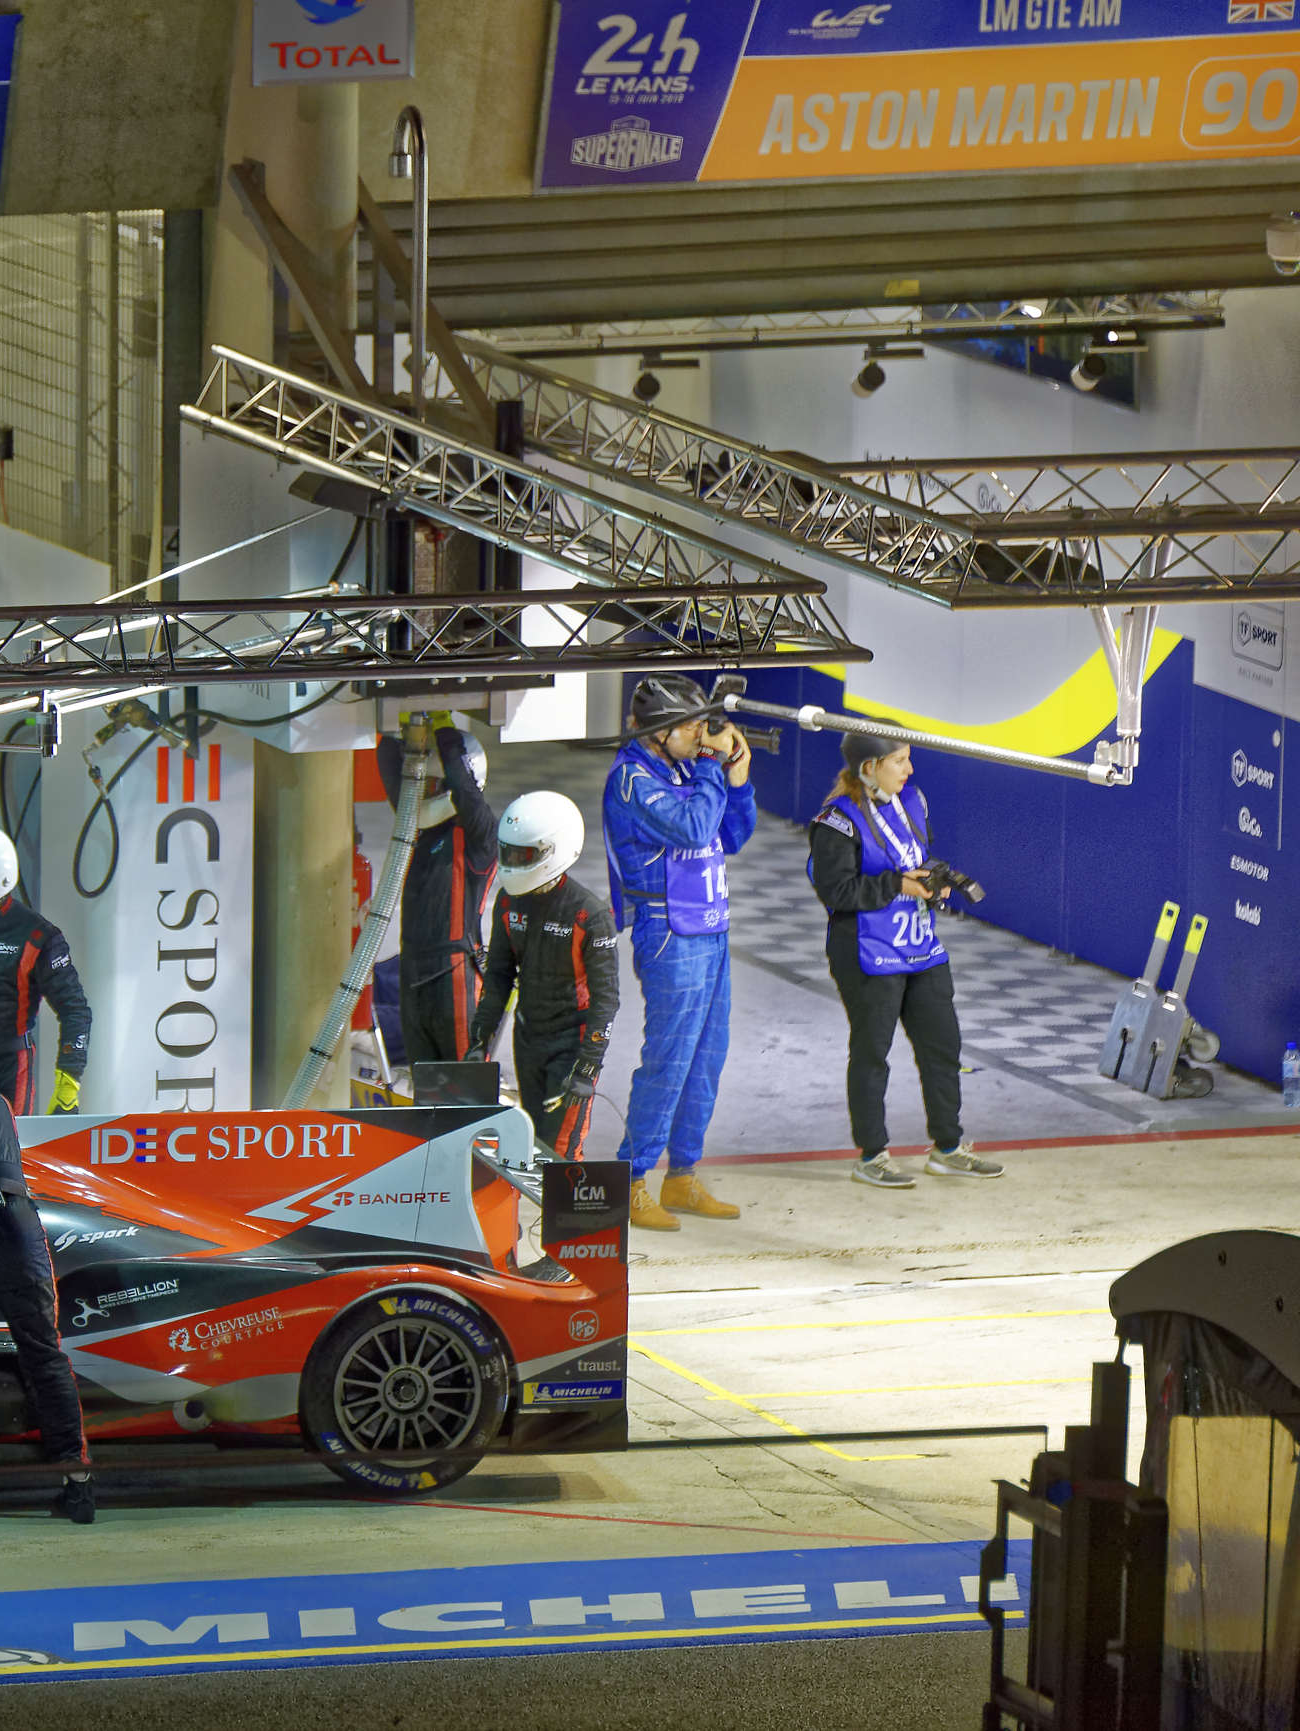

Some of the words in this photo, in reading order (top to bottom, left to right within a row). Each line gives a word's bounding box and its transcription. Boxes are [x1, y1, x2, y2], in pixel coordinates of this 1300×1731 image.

[979, 0, 1019, 33] LM
[269, 42, 400, 70] TOTAL
[581, 12, 700, 75] 24h
[575, 77, 610, 95] LE
[612, 75, 690, 94] MANS
[757, 88, 940, 155] ASTON
[948, 76, 1160, 148] MARTIN
[1199, 68, 1298, 136] 90
[573, 130, 680, 170] SUPERFINALE
[1252, 625, 1278, 648] SPORT
[1247, 764, 1275, 790] SPORT
[155, 888, 220, 1112] SPOR
[90, 1126, 198, 1165] IDEC
[207, 1123, 363, 1161] SPORT
[359, 1190, 451, 1206] BANORTE
[573, 1185, 605, 1201] ICM
[79, 1226, 140, 1244] spark
[558, 1243, 619, 1260] MOTUL
[97, 1279, 178, 1305] REBELLION
[194, 1306, 280, 1339] CHEVREUSE
[200, 1320, 284, 1351] COURTAGE
[414, 1298, 488, 1348] MICHELIN
[577, 1358, 621, 1373] traust.
[552, 1385, 612, 1398] MICHELIN
[73, 1573, 1022, 1650] MICHELI
